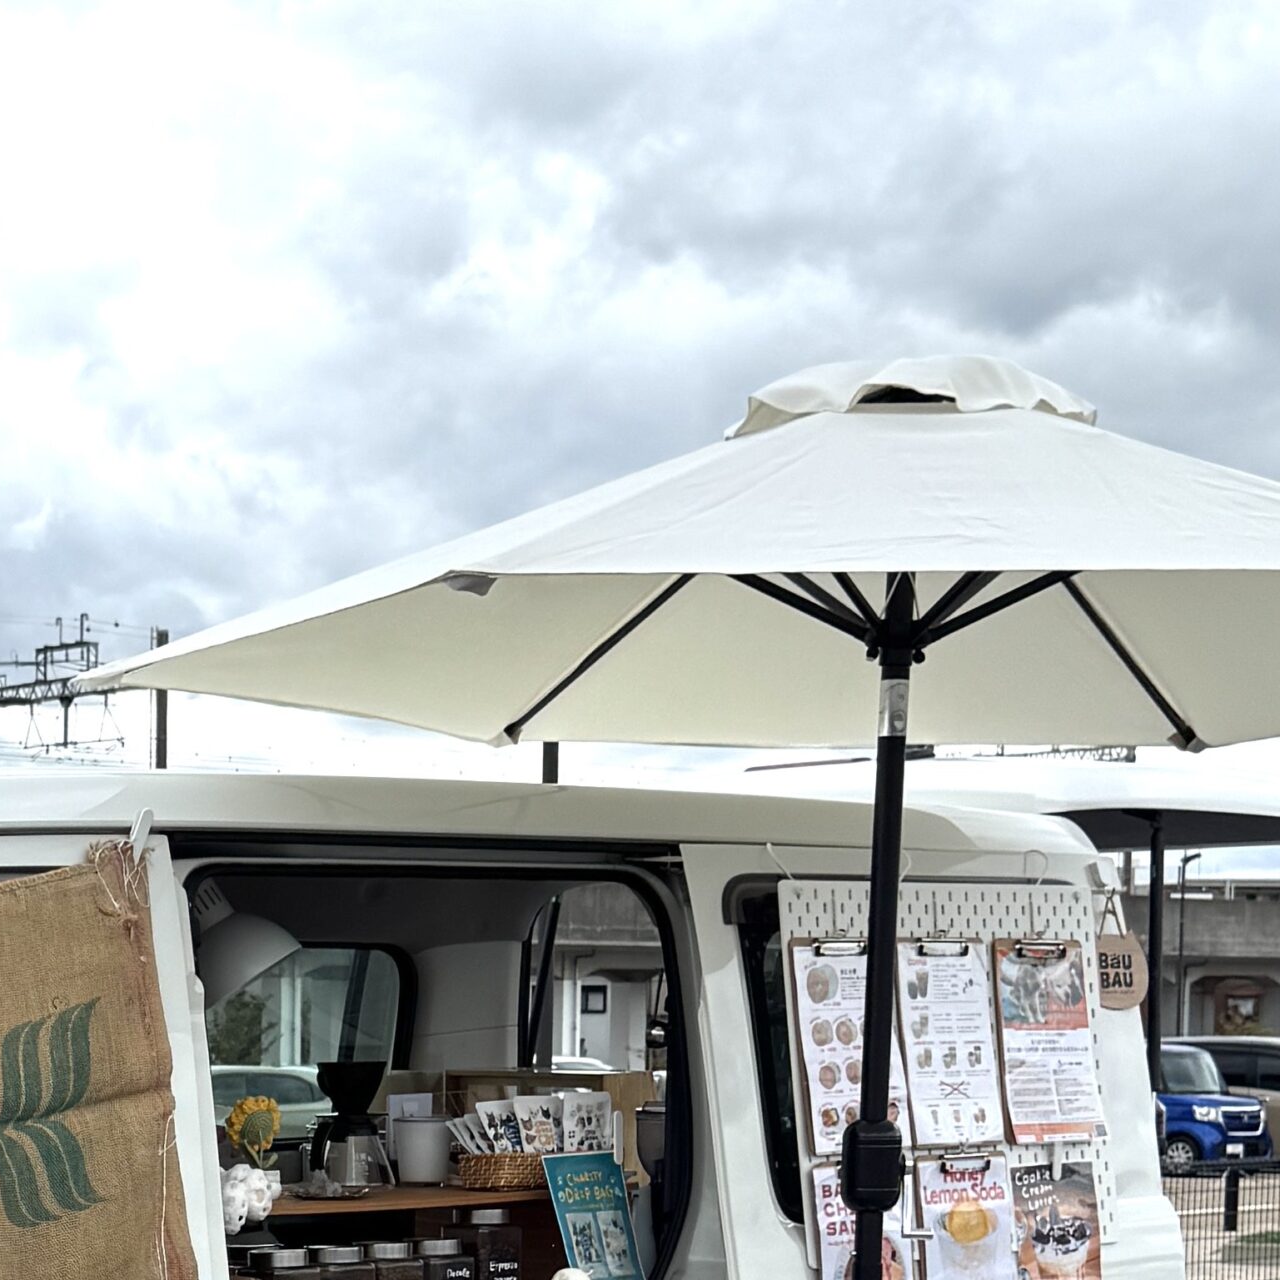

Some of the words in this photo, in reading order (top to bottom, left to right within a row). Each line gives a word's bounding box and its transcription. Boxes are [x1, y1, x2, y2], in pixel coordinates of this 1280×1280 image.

[1100, 970, 1134, 989] BAU
[566, 1170, 604, 1187] CHARITY
[943, 1164, 986, 1183] Honey
[1014, 1169, 1051, 1186] Cookie
[565, 1186, 591, 1205] DRIP
[593, 1184, 616, 1201] BAG
[923, 1184, 969, 1206] Lemon
[970, 1182, 1006, 1202] Soda
[1021, 1184, 1054, 1198] Cream
